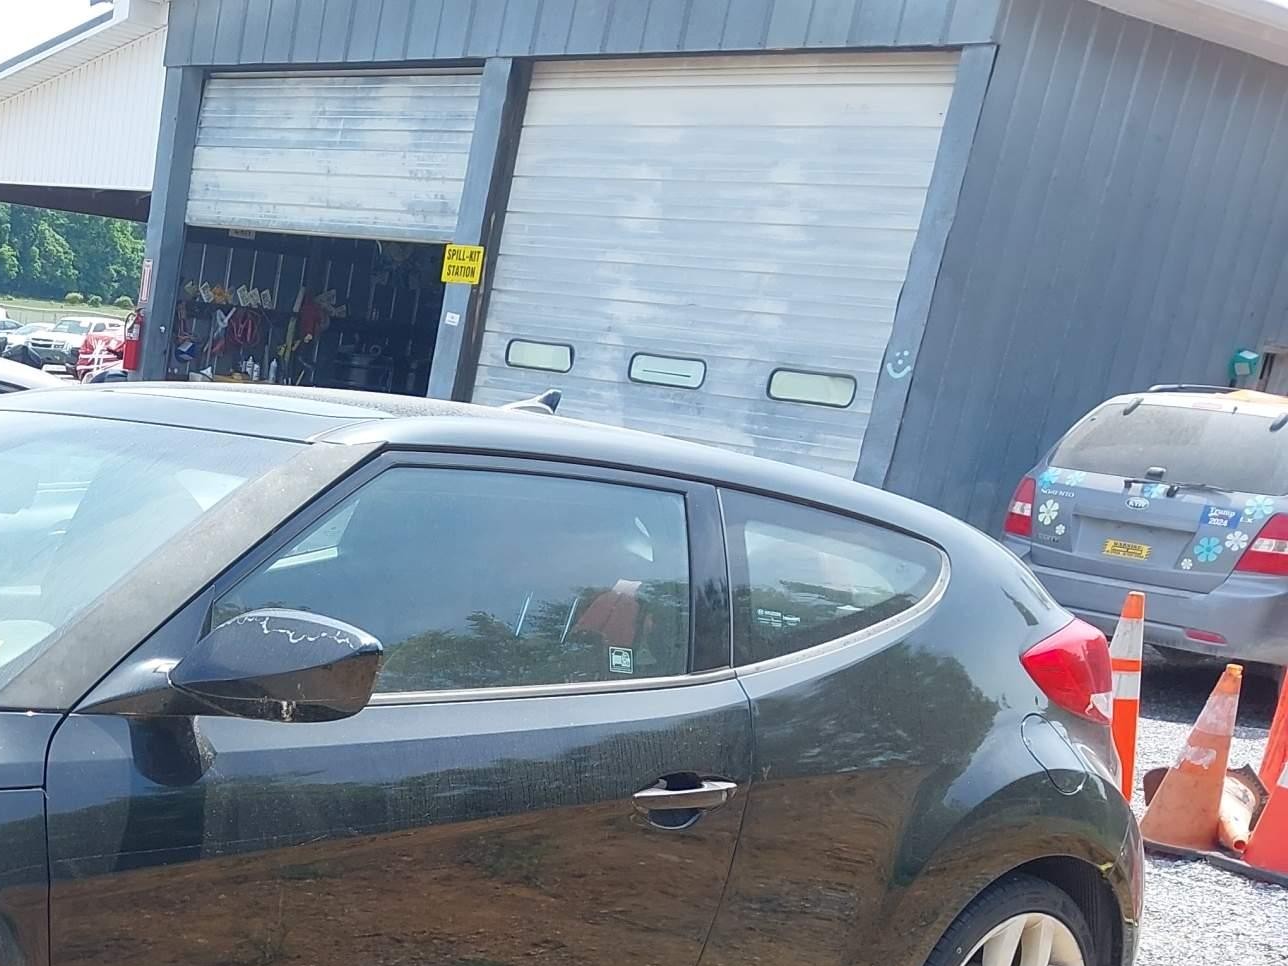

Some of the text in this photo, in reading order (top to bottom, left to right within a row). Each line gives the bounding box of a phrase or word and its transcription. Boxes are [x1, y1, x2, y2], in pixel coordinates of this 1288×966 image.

[447, 248, 481, 262] SPILL-KIT
[447, 264, 476, 278] STATION
[1207, 506, 1236, 518] Trump
[1207, 517, 1229, 527] 2024
